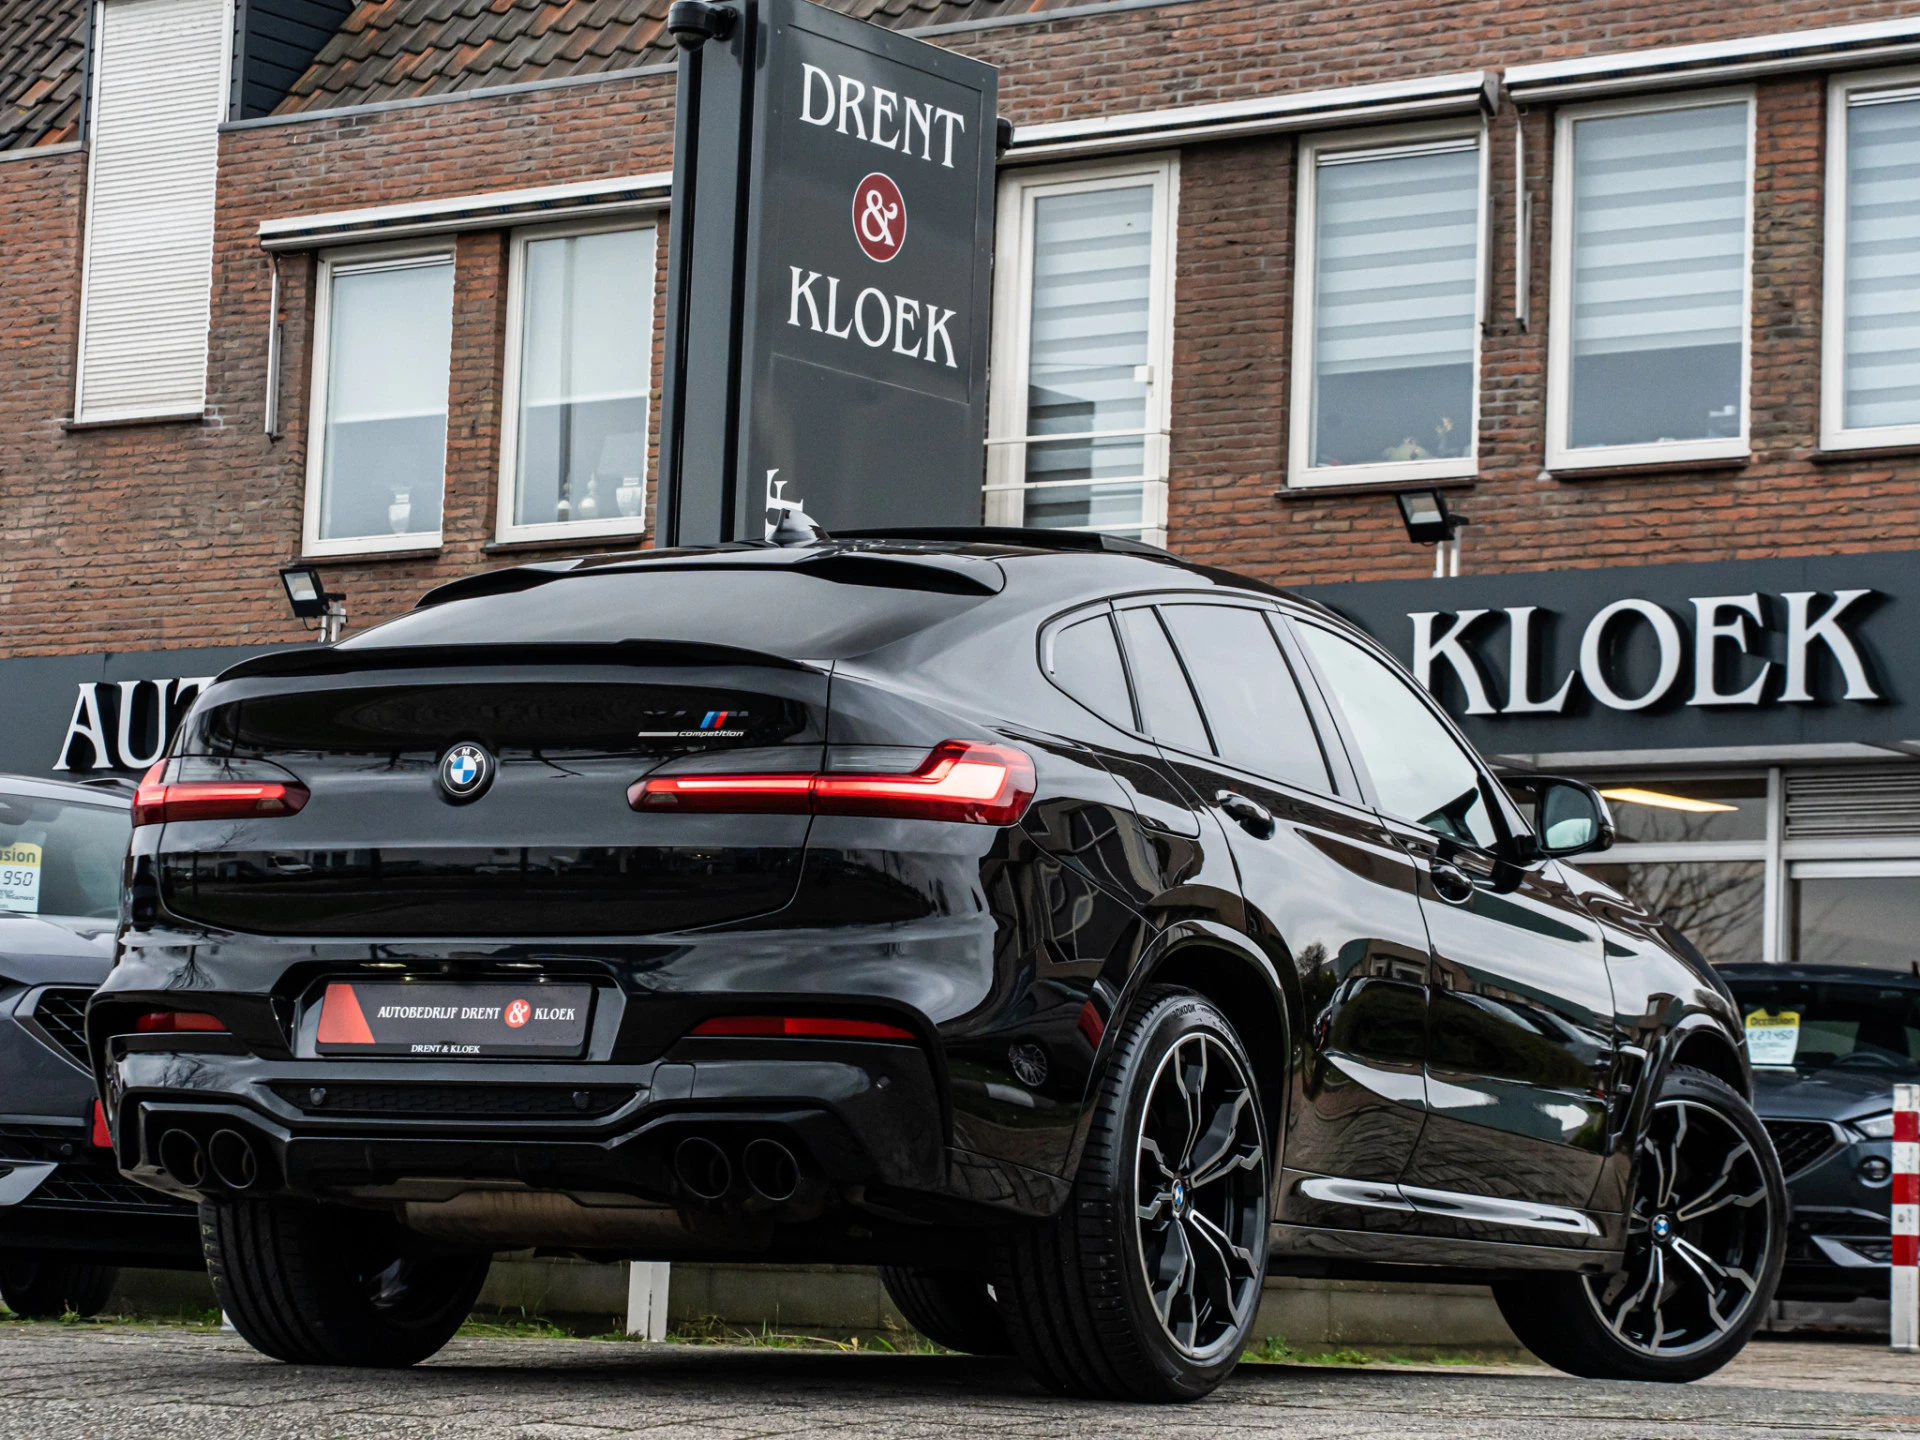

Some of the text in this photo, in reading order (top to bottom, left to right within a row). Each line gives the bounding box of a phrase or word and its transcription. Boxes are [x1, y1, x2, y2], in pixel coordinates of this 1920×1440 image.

[799, 62, 965, 169] DRENT
[861, 189, 898, 247] &
[787, 265, 958, 369] KLOEK
[1406, 588, 1879, 715] KLOEK
[679, 730, 744, 738] competition
[377, 1001, 576, 1024] AUTOBEDRIJF DRENT & KLOEK
[410, 1044, 442, 1053] DRENT
[450, 1045, 481, 1054] KLOEK
